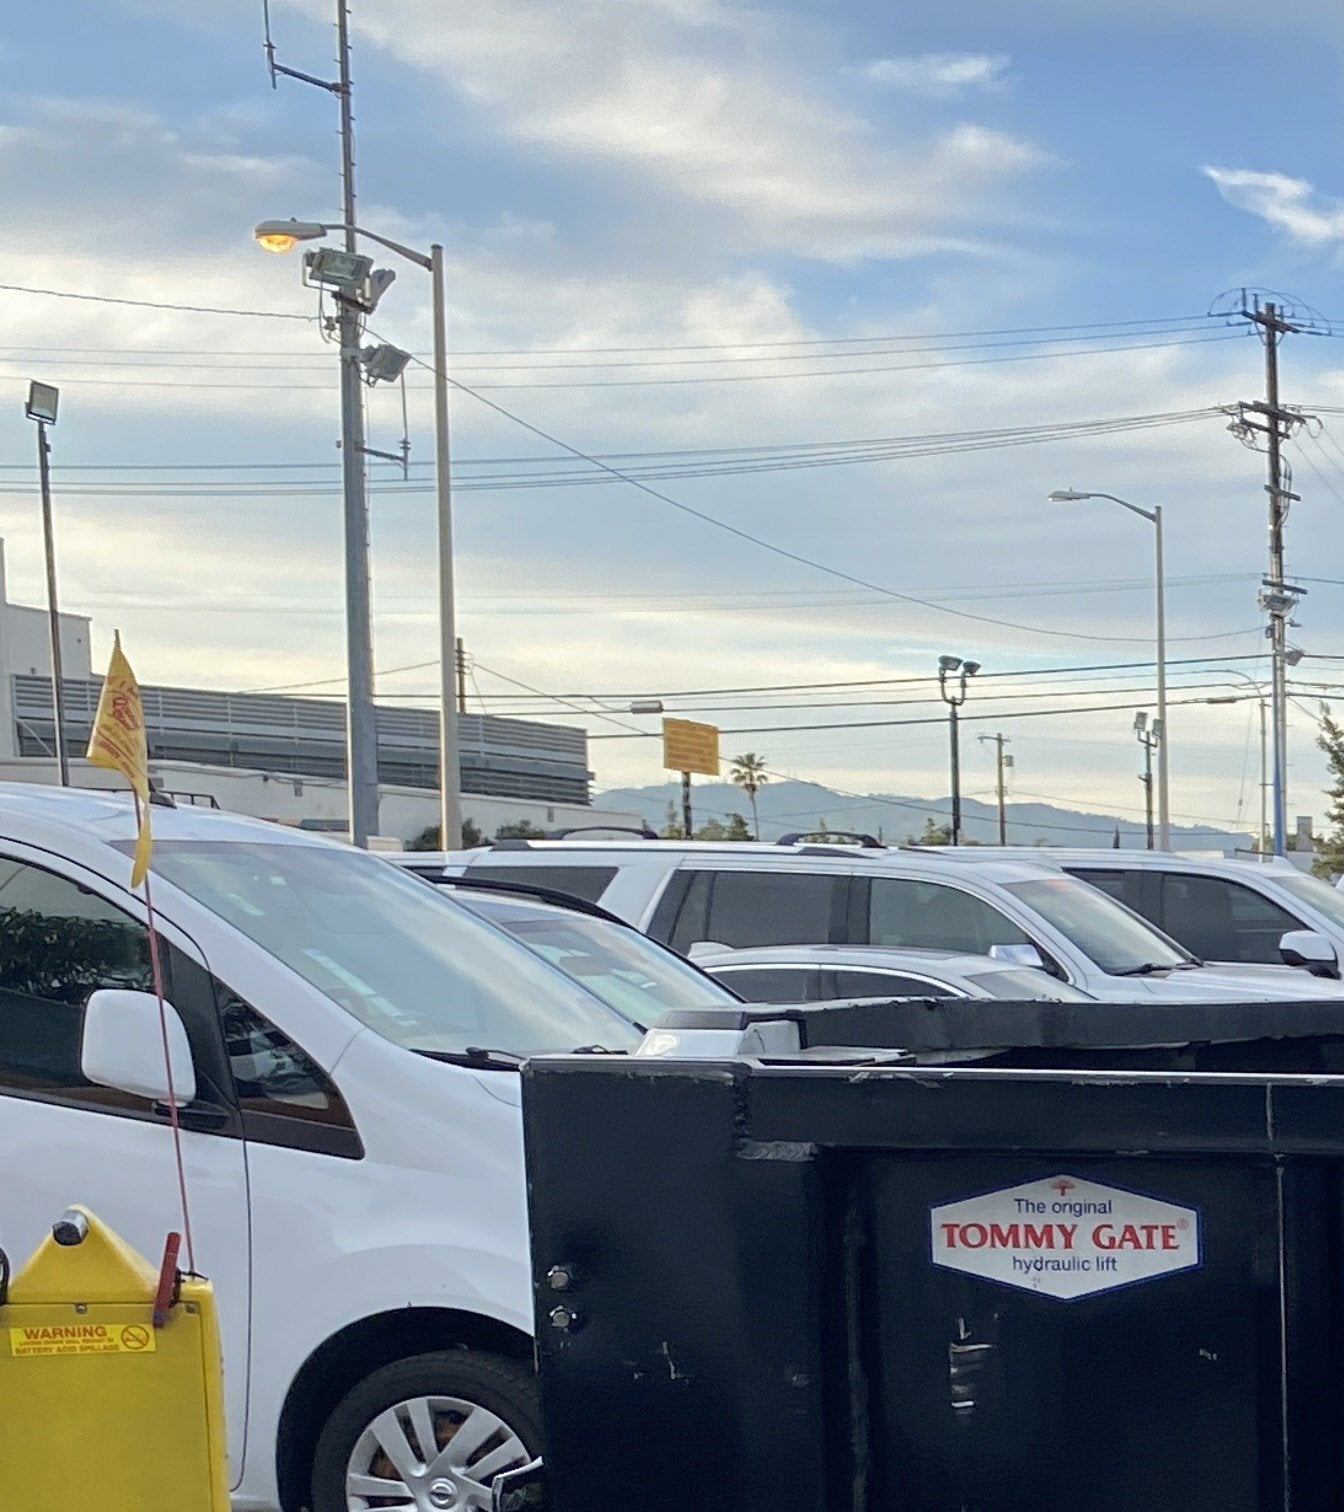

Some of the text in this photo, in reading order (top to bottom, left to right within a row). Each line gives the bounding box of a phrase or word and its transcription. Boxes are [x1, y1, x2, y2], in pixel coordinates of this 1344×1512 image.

[1013, 1198, 1112, 1218] The original
[941, 1223, 1180, 1250] TOMMY GATE
[1012, 1256, 1118, 1275] hydraulic lift
[24, 1325, 108, 1340] WARNING
